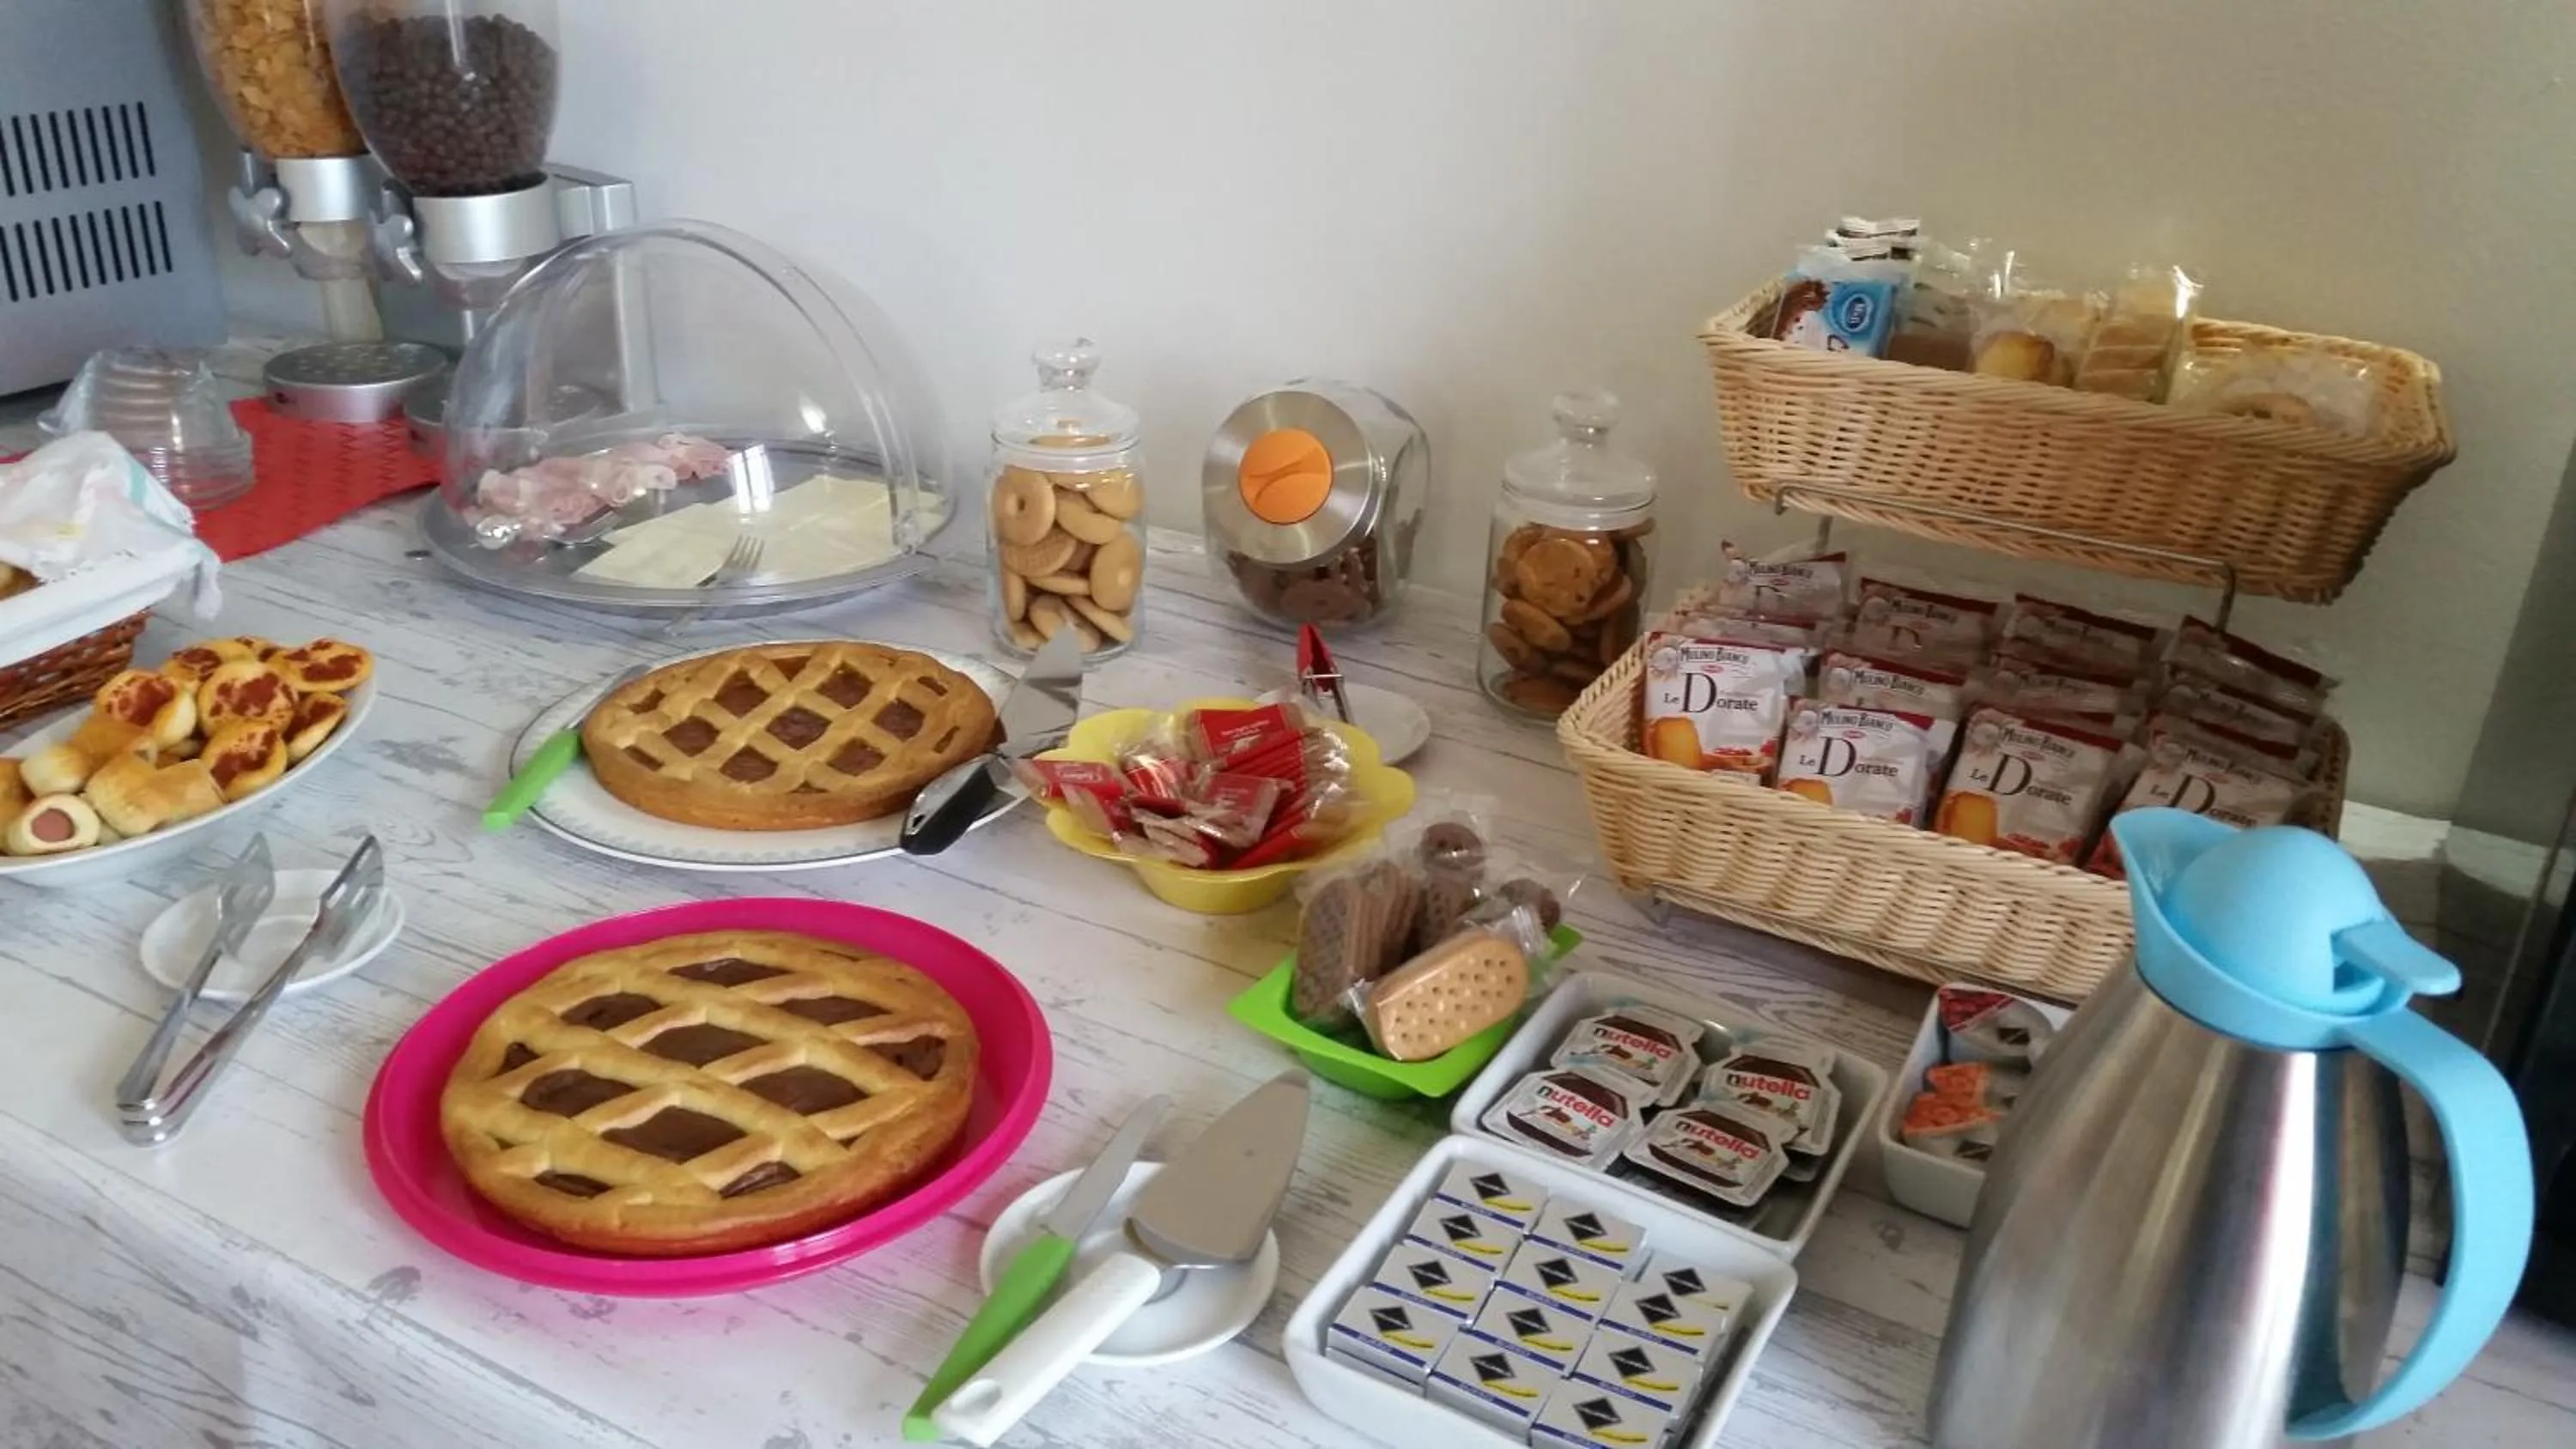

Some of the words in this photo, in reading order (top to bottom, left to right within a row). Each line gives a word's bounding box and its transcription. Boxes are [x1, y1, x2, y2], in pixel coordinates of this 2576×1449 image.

[1593, 1026, 1673, 1060] nutella
[1726, 1073, 1811, 1100] nutella
[1536, 1085, 1615, 1129] nutella
[1675, 1119, 1760, 1160] nutella
